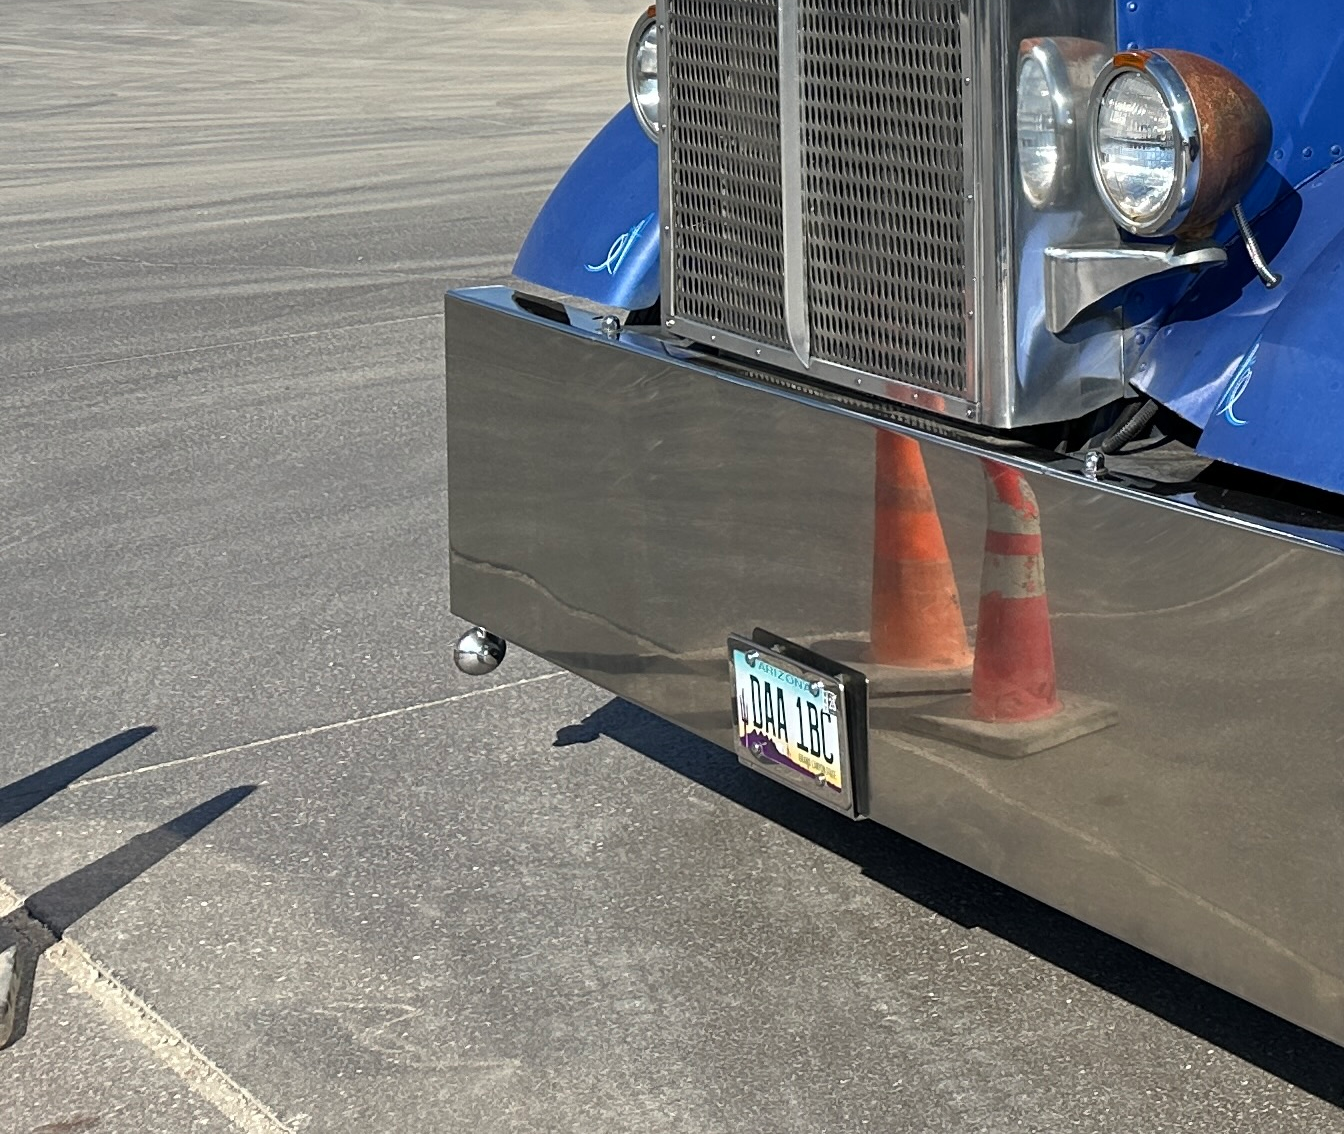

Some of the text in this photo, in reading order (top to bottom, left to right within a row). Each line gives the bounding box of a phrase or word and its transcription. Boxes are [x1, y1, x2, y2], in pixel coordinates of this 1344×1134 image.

[758, 662, 811, 691] ARIZONA
[750, 674, 834, 764] DAA 1BC
